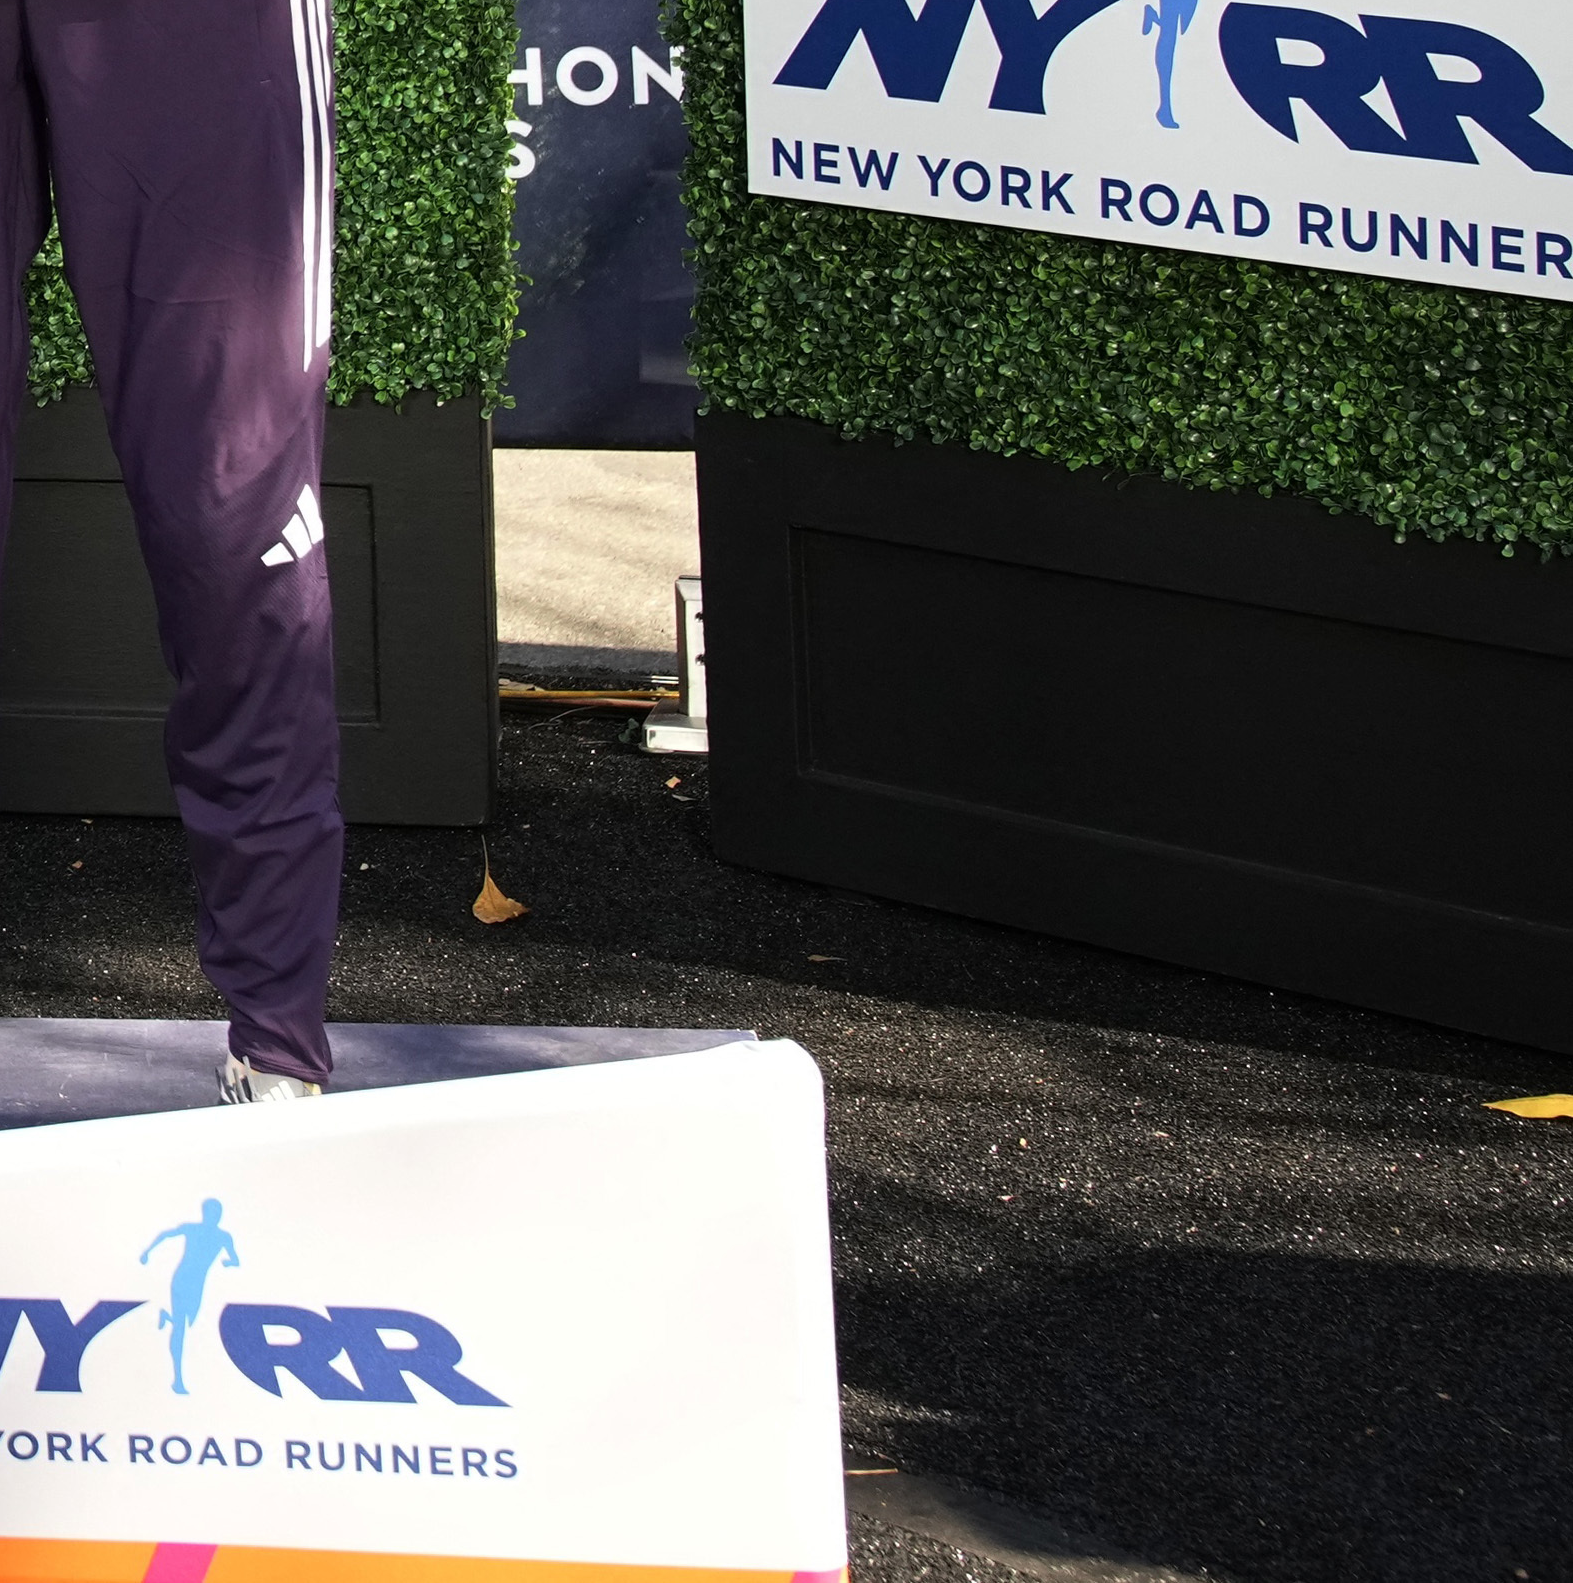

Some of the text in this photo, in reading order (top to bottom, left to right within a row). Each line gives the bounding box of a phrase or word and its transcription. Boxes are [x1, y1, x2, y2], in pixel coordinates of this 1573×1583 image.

[770, 137, 1573, 280] NEW YORK ROAD RUNNER
[217, 1301, 513, 1408] RR
[128, 1431, 264, 1469] ROAD
[283, 1437, 519, 1481] RUNNERS
